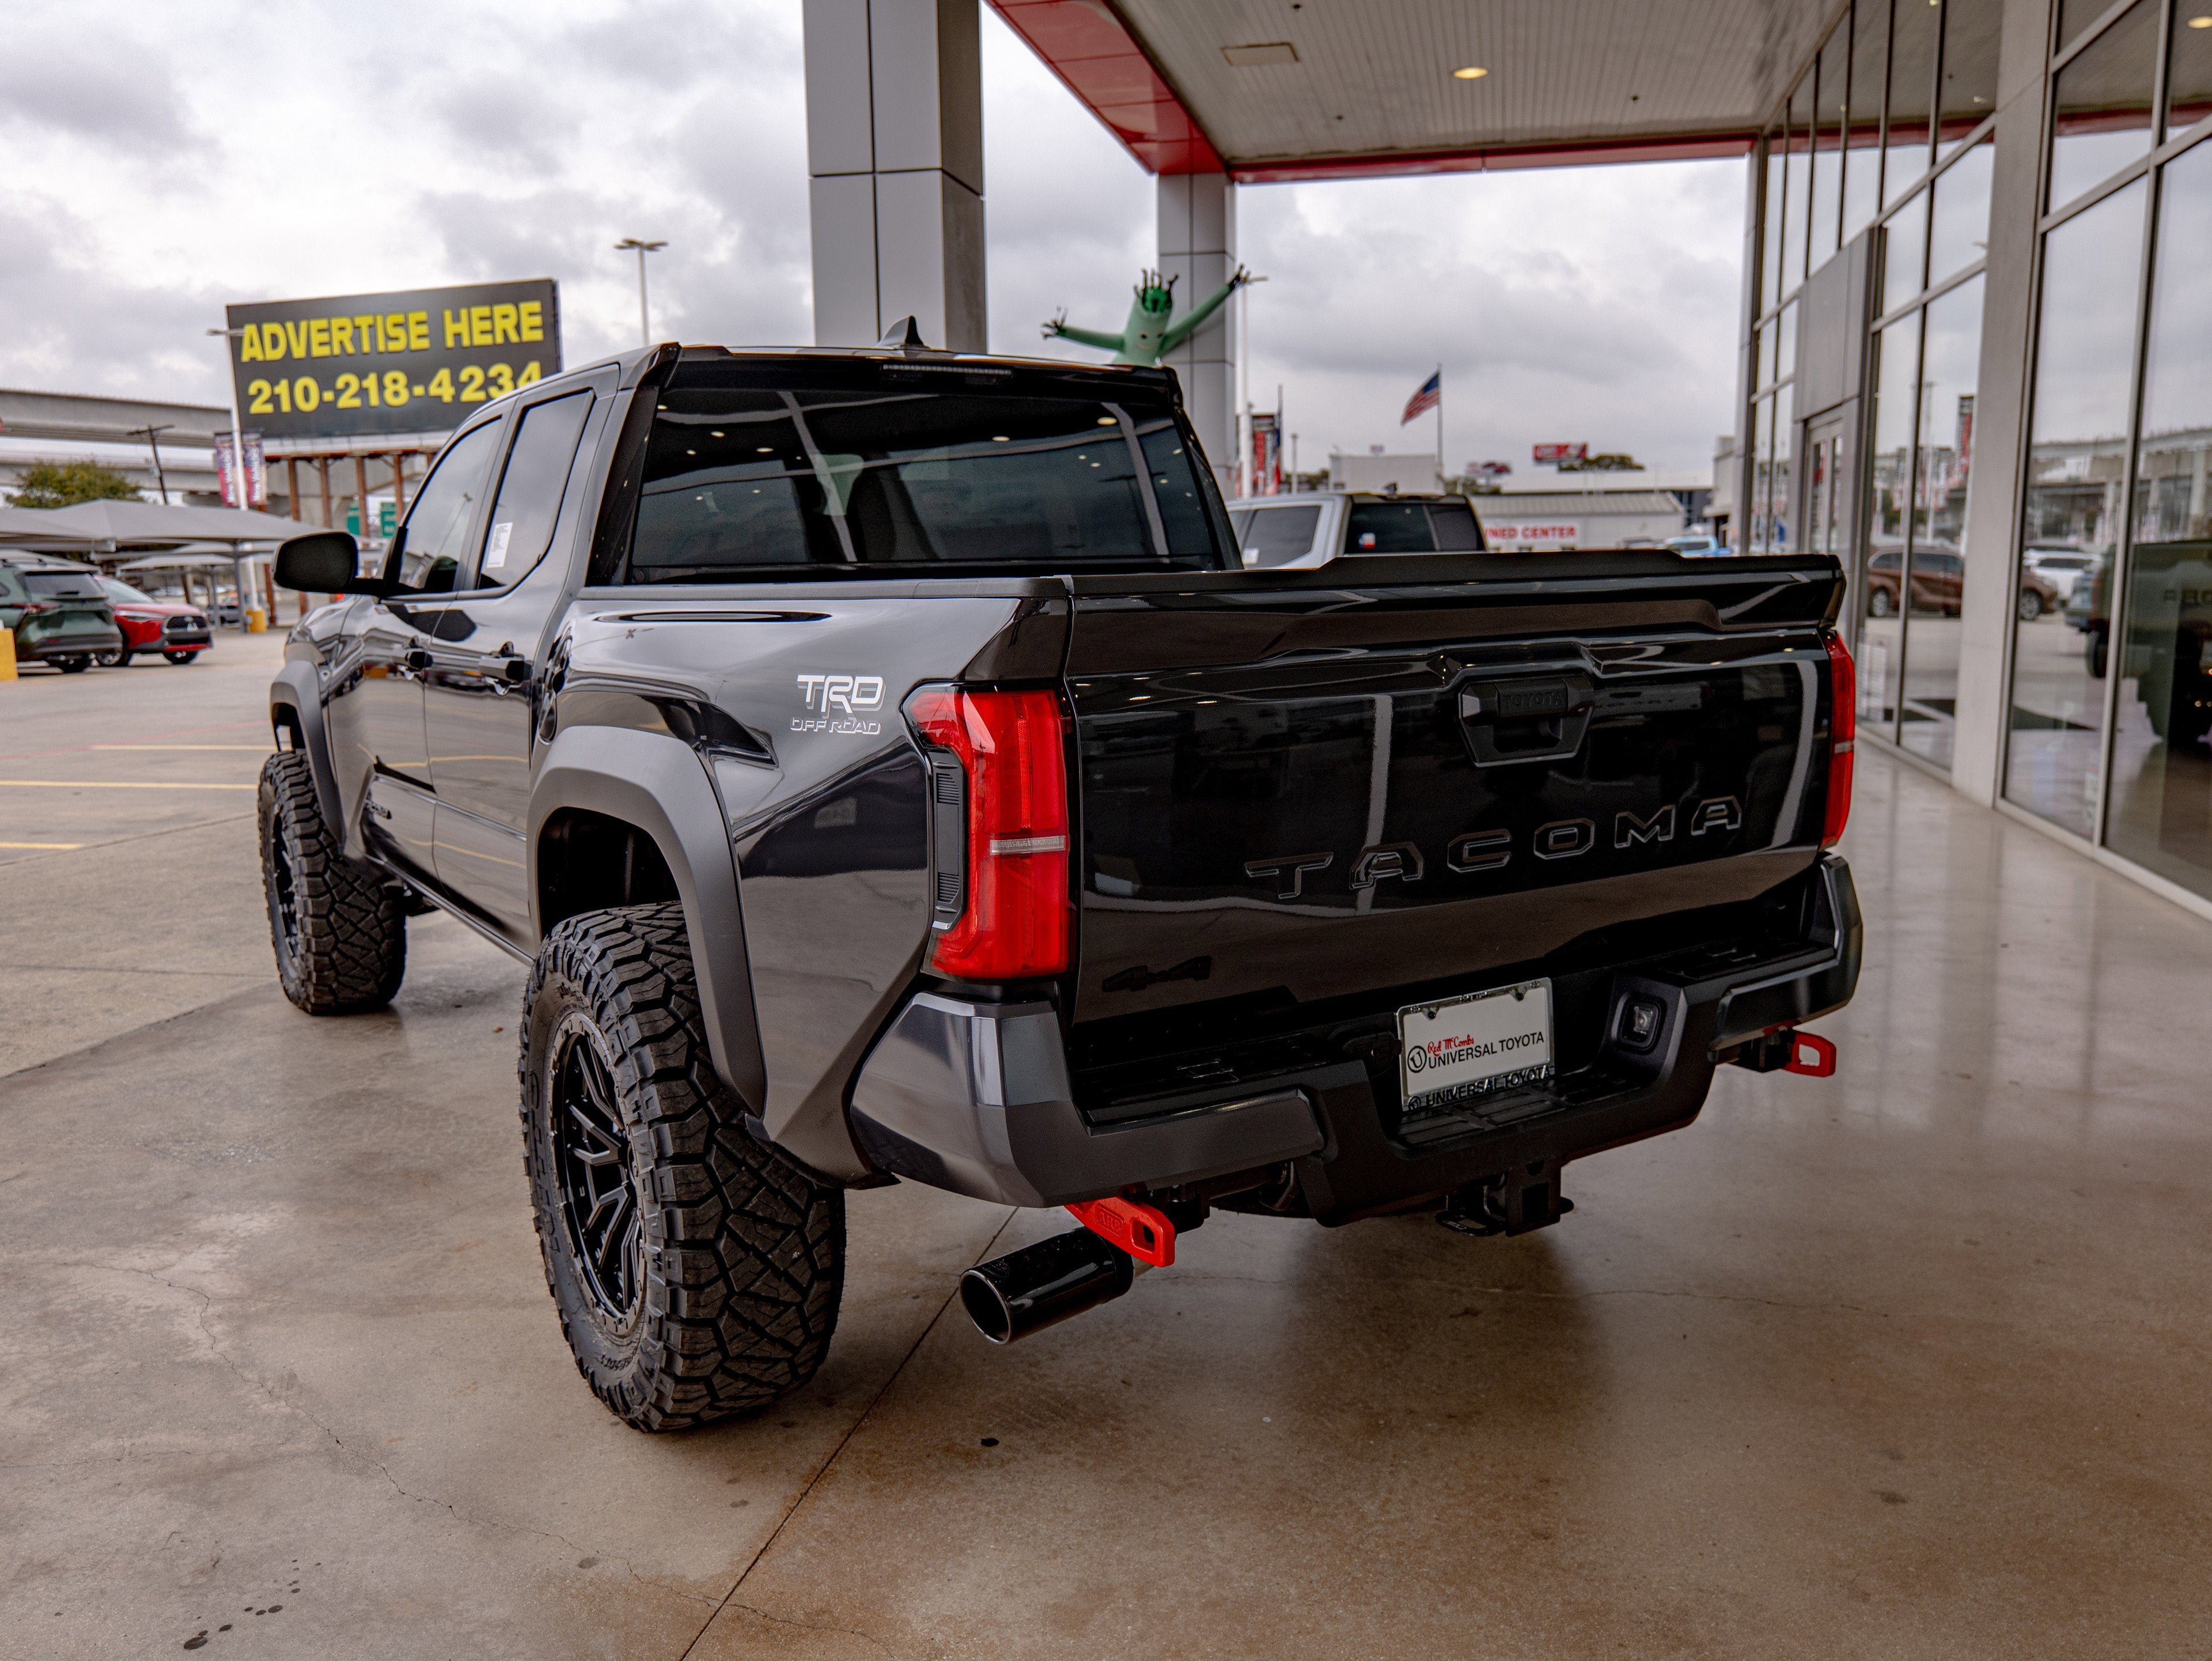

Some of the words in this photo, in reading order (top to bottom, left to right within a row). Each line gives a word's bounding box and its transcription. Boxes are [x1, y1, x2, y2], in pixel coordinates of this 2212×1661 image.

[241, 309, 430, 362] ADVERTISE
[443, 300, 543, 349] HERE
[1521, 525, 1576, 539] CENTER
[797, 675, 885, 720] TRD
[790, 718, 827, 732] OFF
[1244, 794, 1743, 899] TACOMA
[1427, 1041, 1442, 1057] Red
[1429, 1042, 1497, 1069] UNIVERSAL
[1499, 1031, 1544, 1051] TOYOTA
[1426, 1077, 1501, 1106] UNIVERSAL
[1502, 1065, 1551, 1088] TOYOTA
